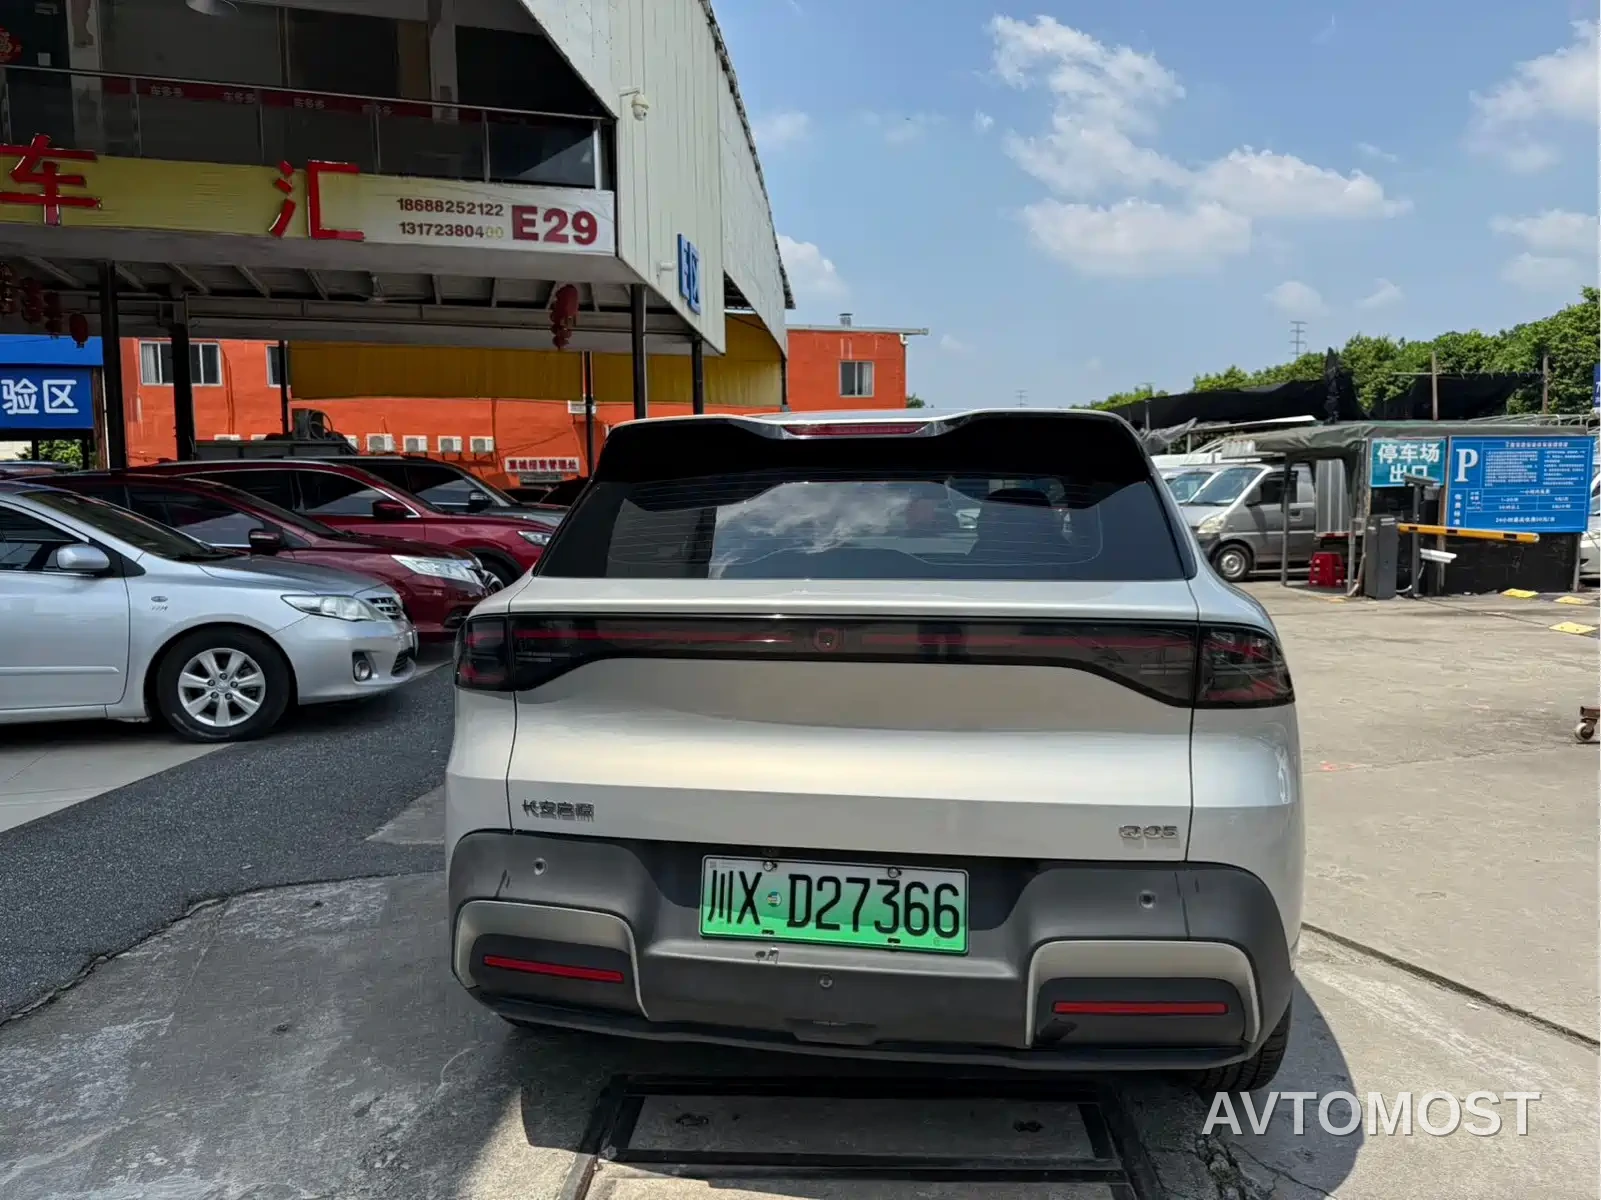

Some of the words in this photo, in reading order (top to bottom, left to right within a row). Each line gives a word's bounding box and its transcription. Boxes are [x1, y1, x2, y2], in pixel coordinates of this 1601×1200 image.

[396, 198, 504, 217] 18688252122
[511, 204, 598, 246] E29
[1, 378, 79, 415] 验区
[1377, 443, 1440, 464] 停车场
[1455, 448, 1478, 483] P
[1389, 463, 1428, 483] 出口
[707, 869, 763, 926] 川X
[786, 873, 960, 939] D27366
